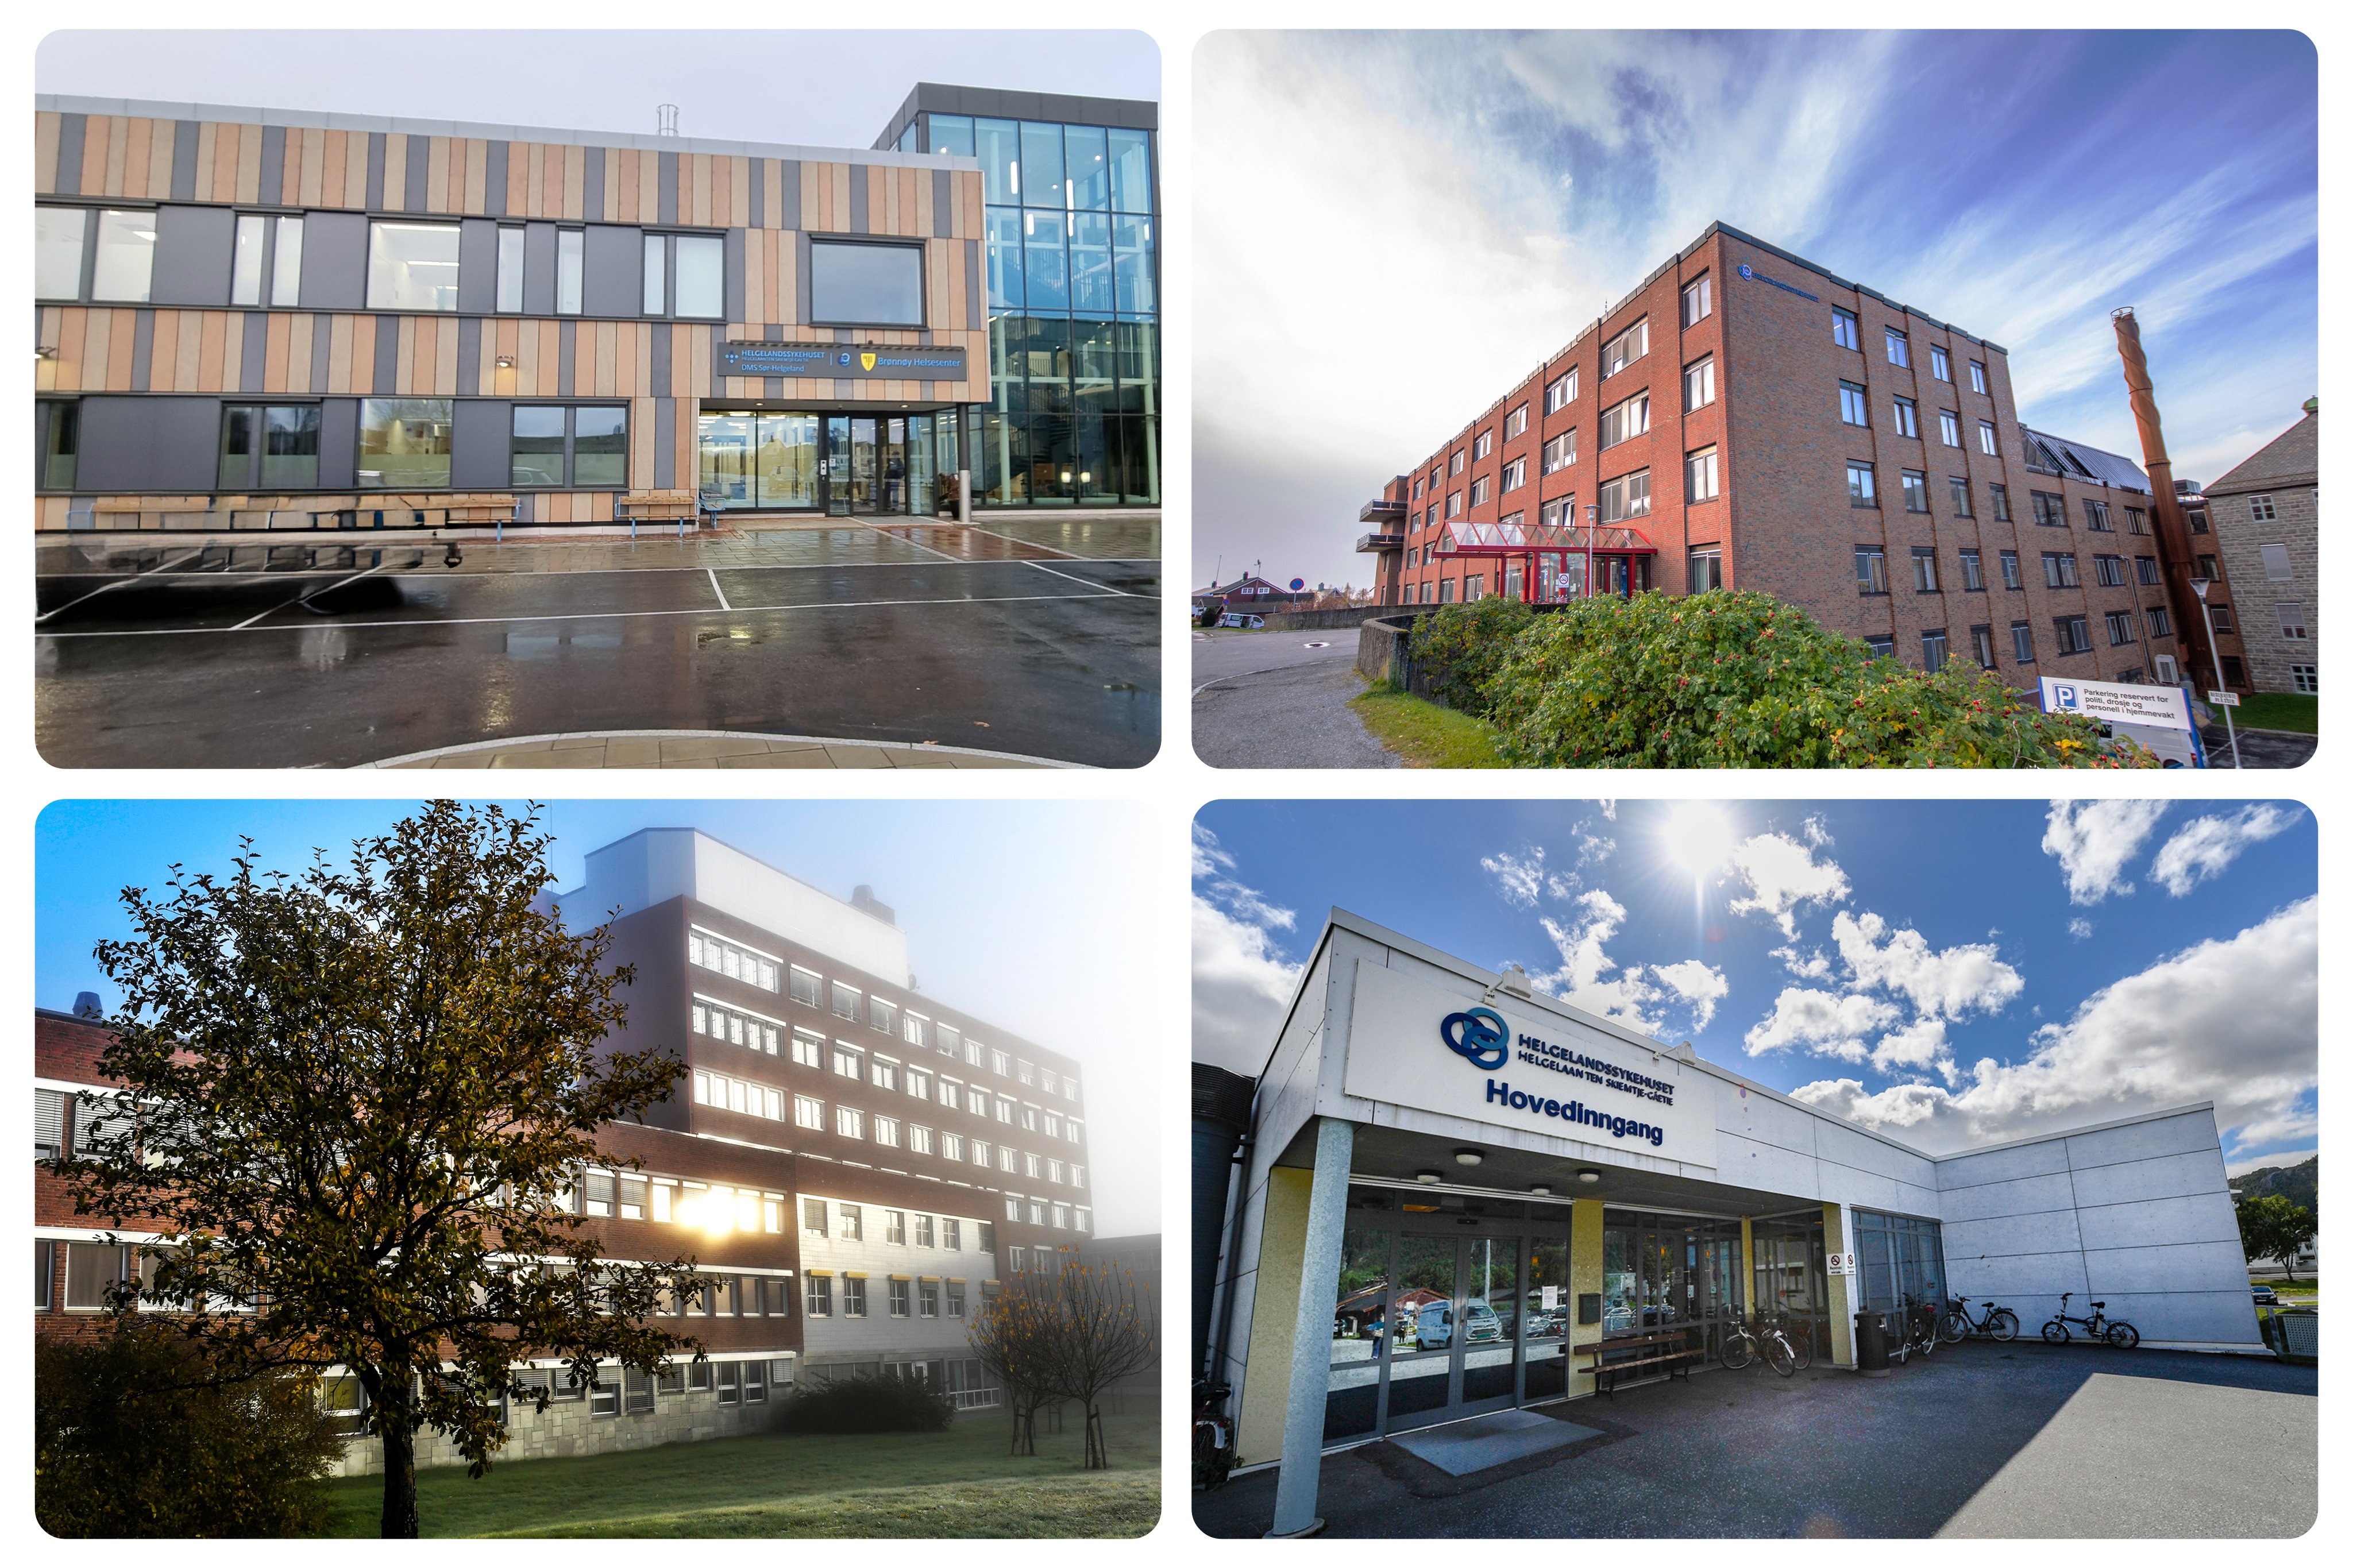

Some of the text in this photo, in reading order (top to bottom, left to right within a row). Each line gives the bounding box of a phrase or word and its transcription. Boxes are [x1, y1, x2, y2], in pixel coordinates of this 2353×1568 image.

[742, 350, 825, 358] HELGELANDSSYKEHUSET
[759, 364, 805, 373] Sør-Helgeland
[878, 357, 961, 368] Brønnøy Helsesenter
[2084, 689, 2118, 699] Parkering
[2120, 693, 2155, 702] reservert
[2085, 696, 2143, 709] politi, drosje og
[2086, 704, 2120, 713] personell
[2126, 708, 2175, 719] hjemmevakt
[1518, 1033, 1675, 1095] HELGELANDSSYKEHUSET
[1518, 1050, 1584, 1079] HELGELAAN
[1585, 1071, 1603, 1084] TEN
[1486, 1078, 1663, 1146] Hovedinngang
